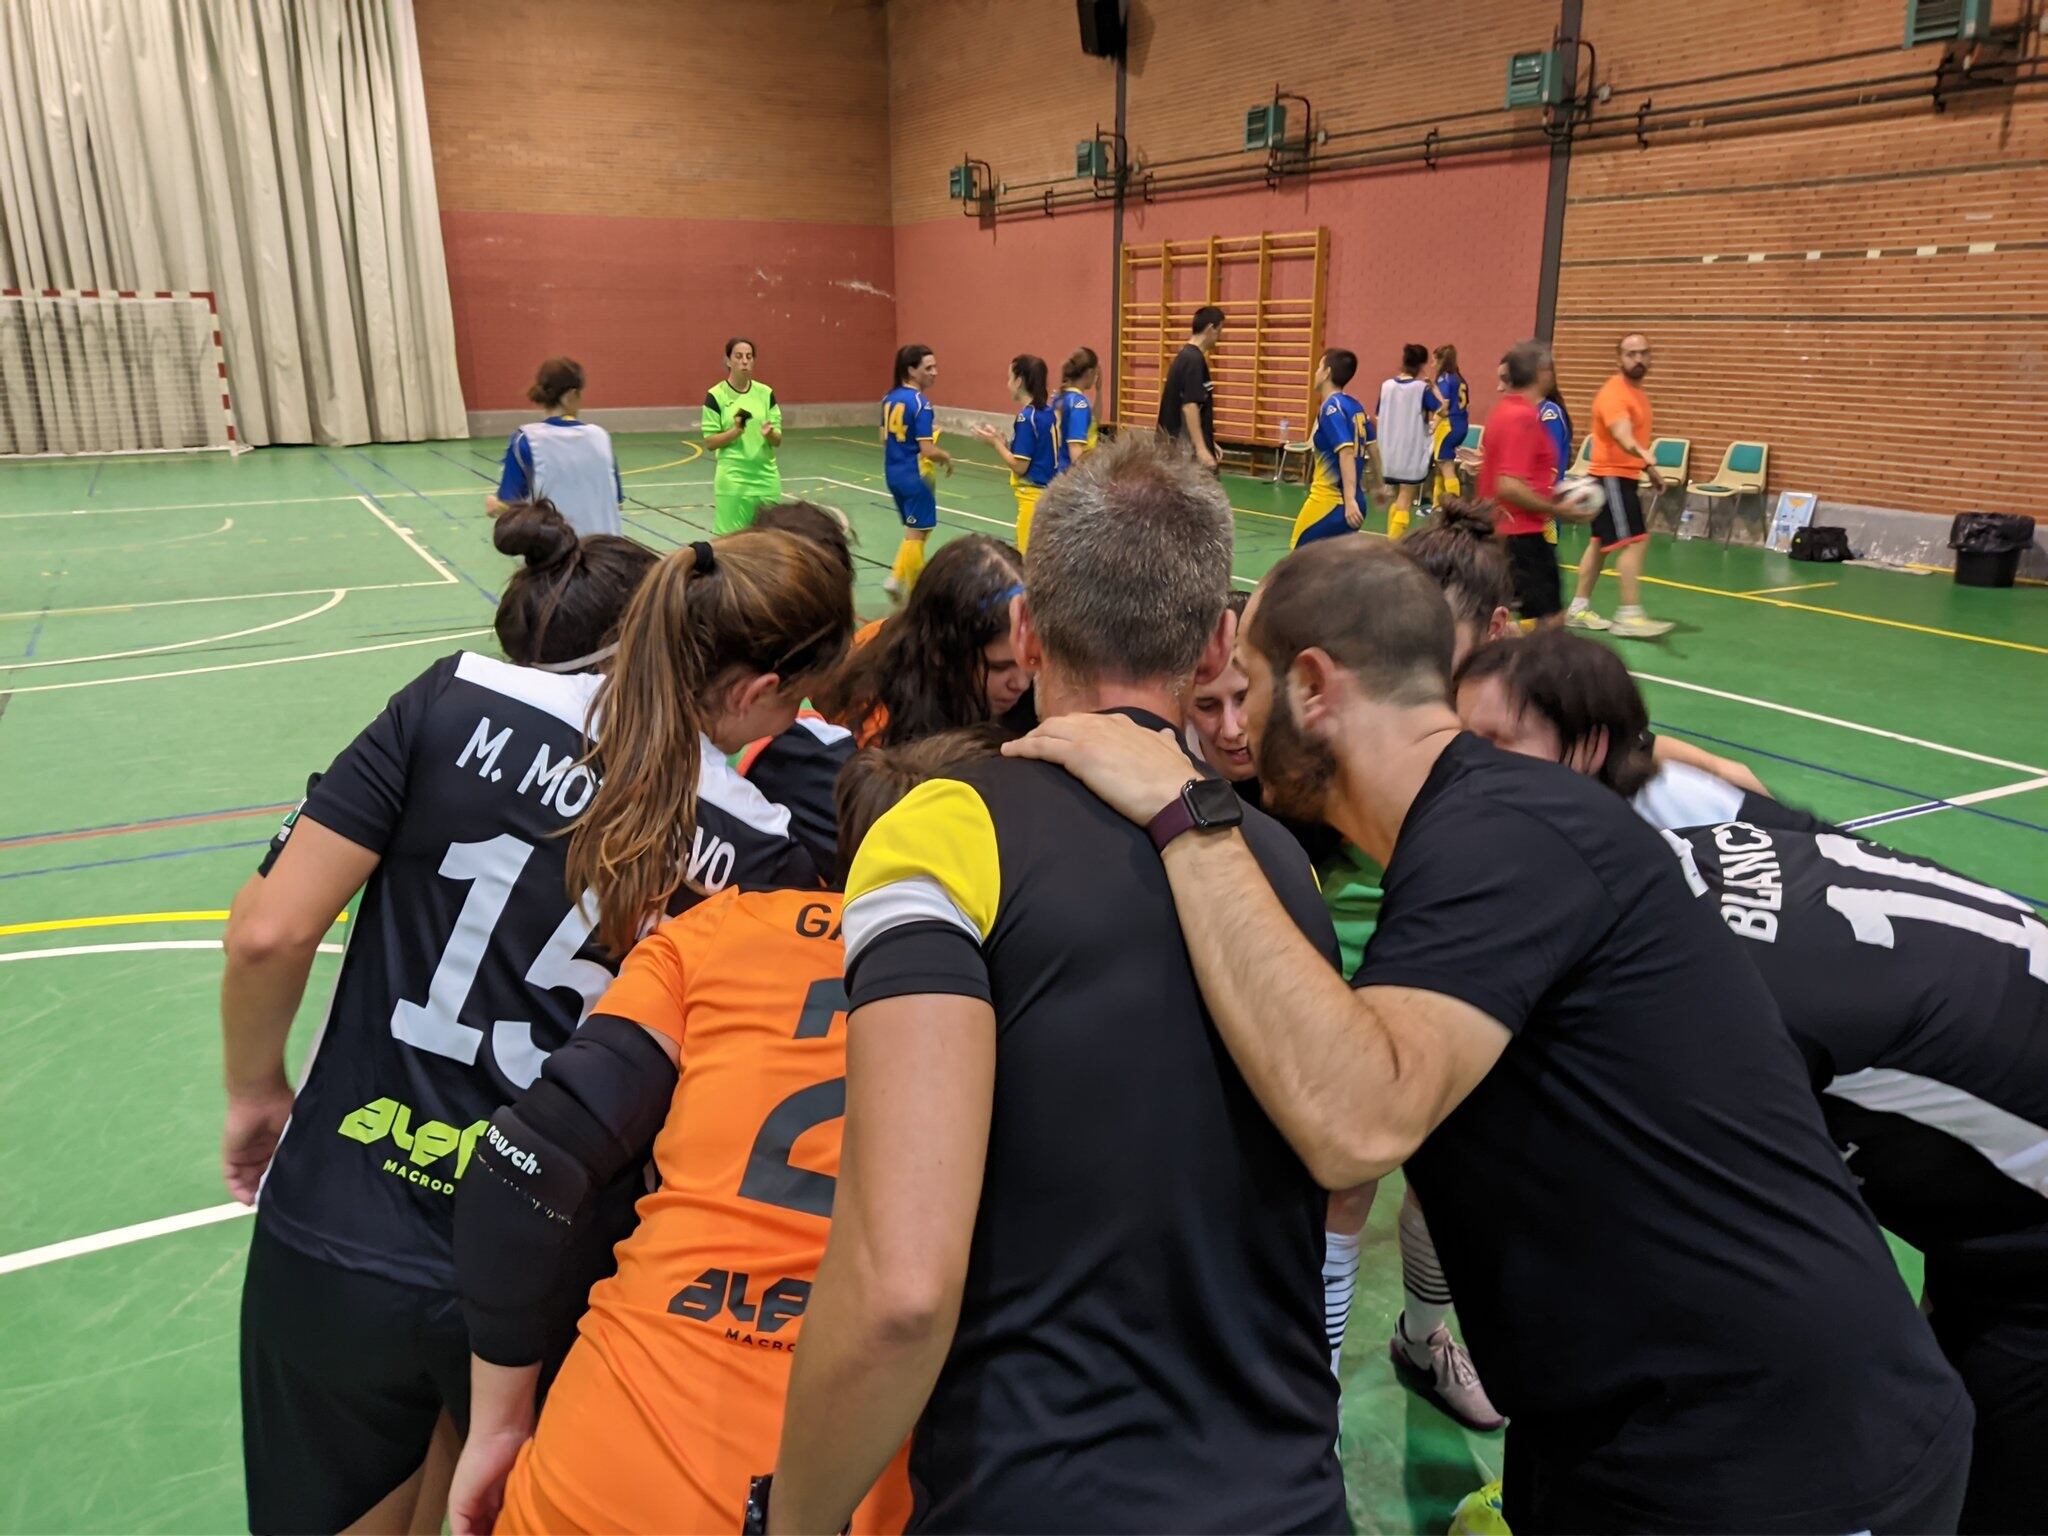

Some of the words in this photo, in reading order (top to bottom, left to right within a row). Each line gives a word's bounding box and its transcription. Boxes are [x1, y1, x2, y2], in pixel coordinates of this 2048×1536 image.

[883, 401, 908, 442] 14
[455, 716, 502, 783] M.
[390, 833, 617, 1090] 15
[486, 1124, 538, 1175] reusch
